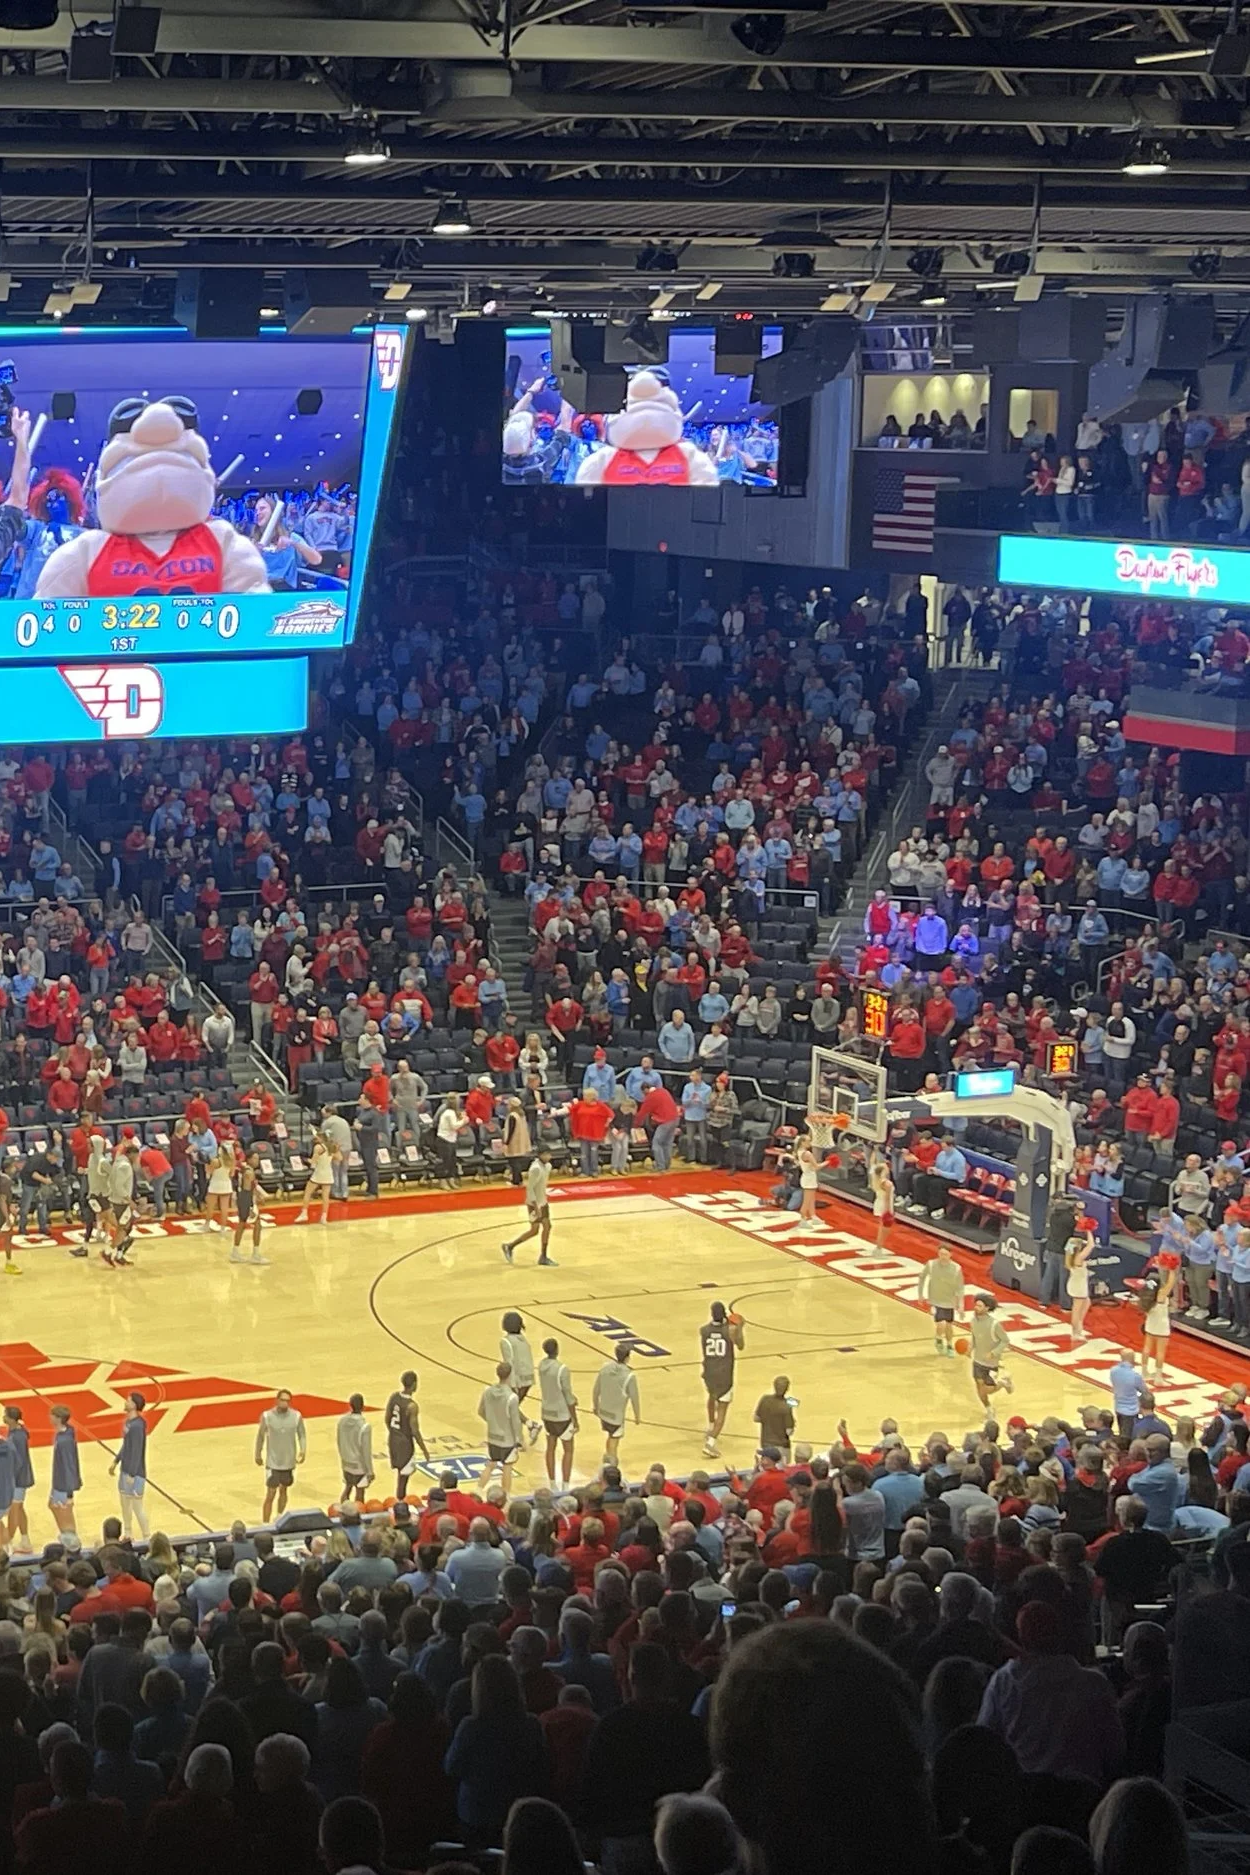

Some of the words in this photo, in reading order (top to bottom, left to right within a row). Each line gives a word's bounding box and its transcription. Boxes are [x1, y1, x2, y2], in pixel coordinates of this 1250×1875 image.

[16, 612, 39, 647] 0
[42, 615, 55, 633] 4
[68, 614, 81, 632] 0
[102, 603, 162, 630] 3:22
[177, 611, 190, 629] 0
[200, 610, 214, 628] 4
[218, 605, 240, 638] 0
[111, 637, 138, 652] 1ST
[1000, 1236, 1037, 1271] Kroger
[705, 1339, 727, 1357] 20
